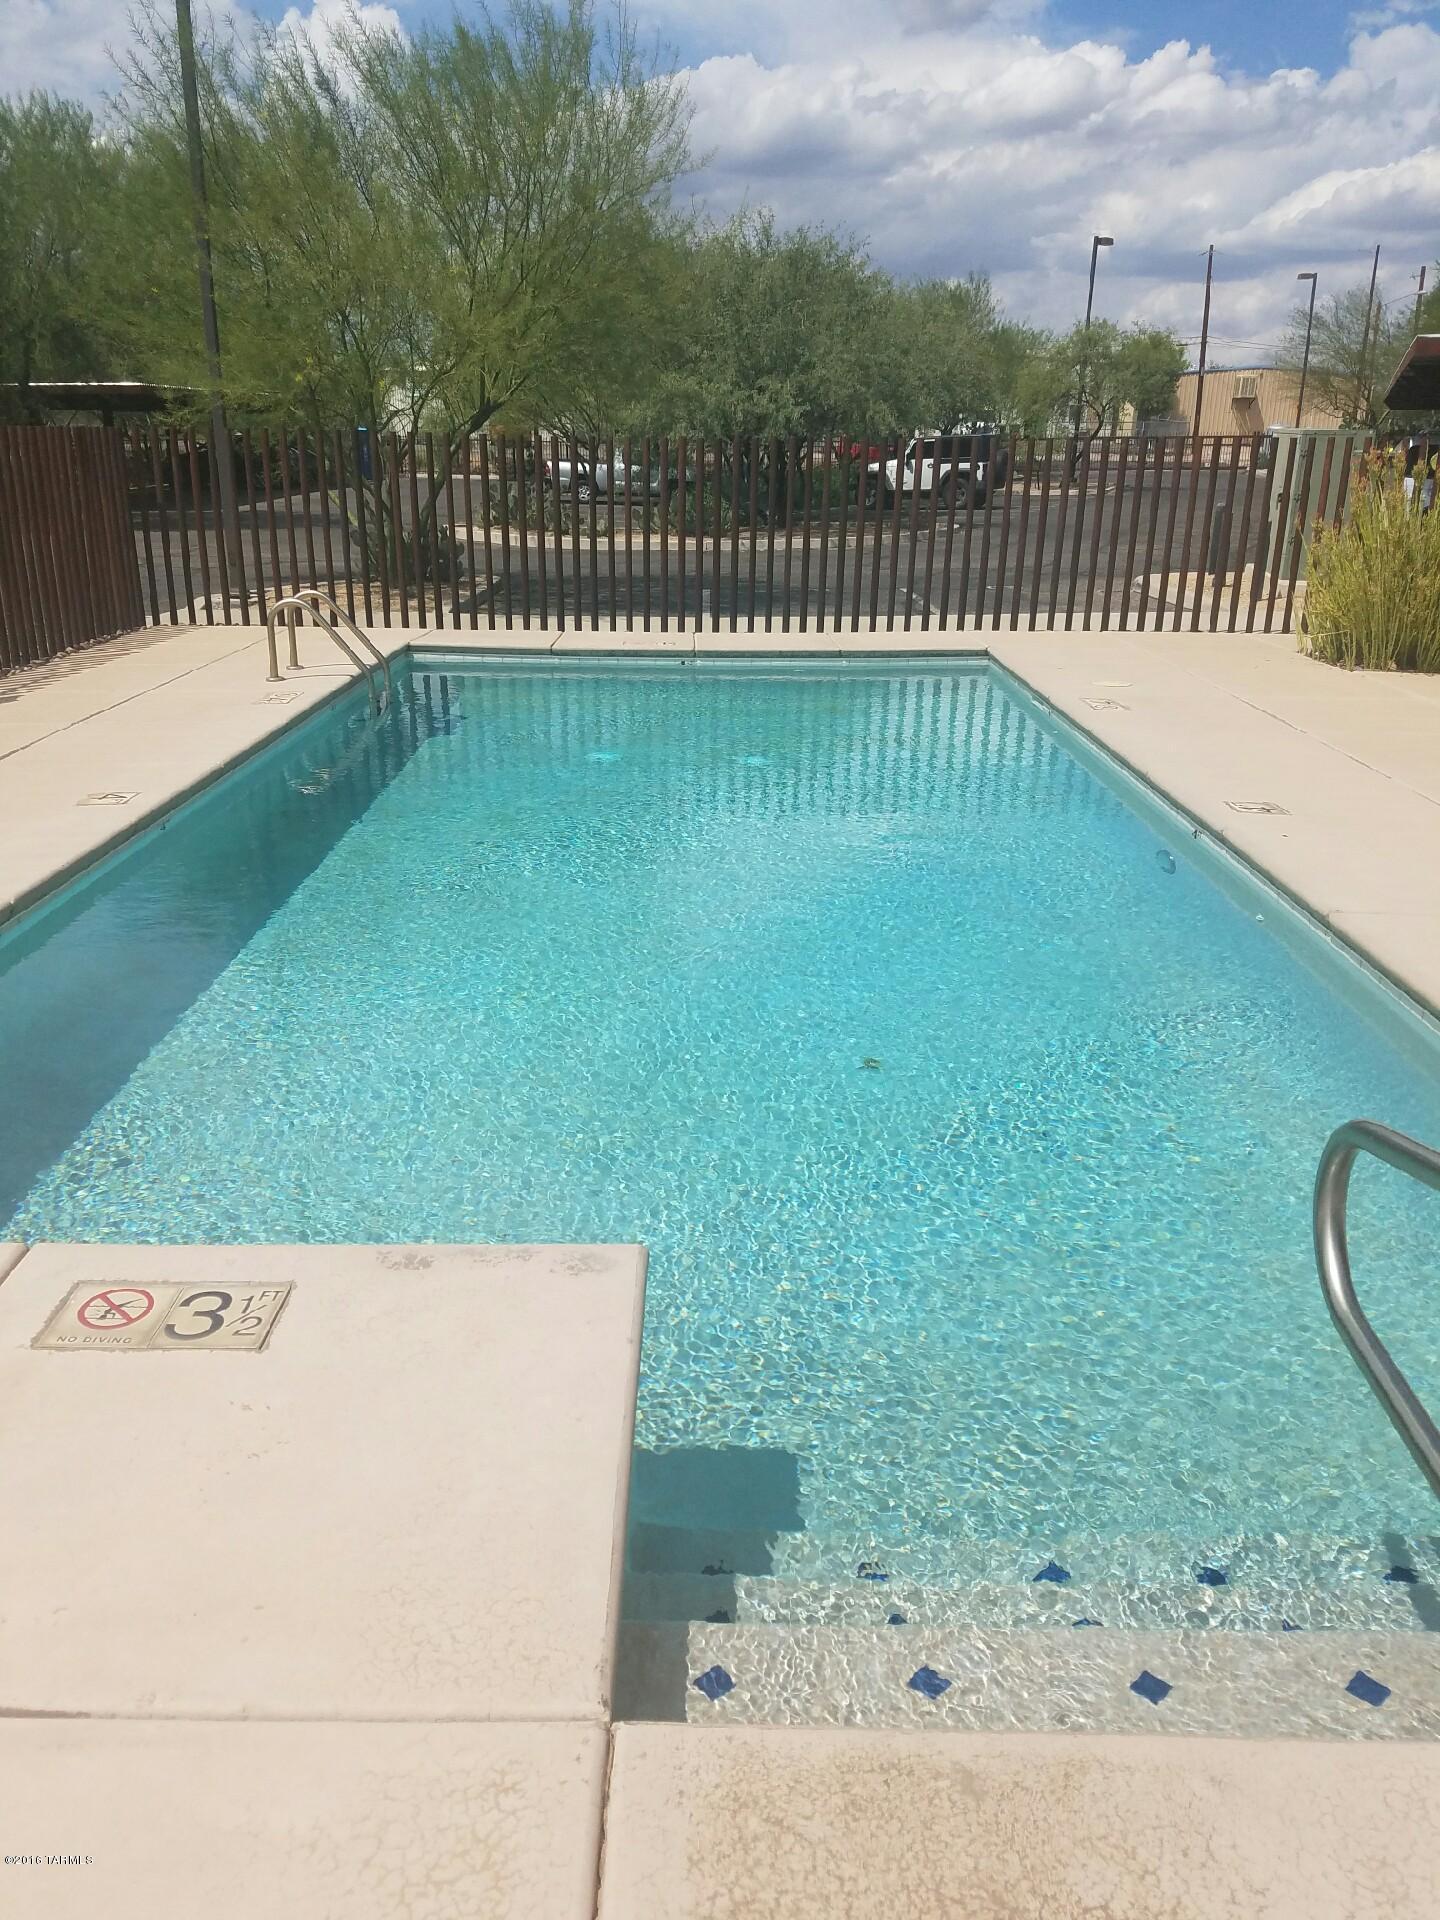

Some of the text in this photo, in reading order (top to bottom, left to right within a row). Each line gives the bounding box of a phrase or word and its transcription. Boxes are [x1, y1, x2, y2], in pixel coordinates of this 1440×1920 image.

[164, 1290, 233, 1341] 3
[258, 1290, 284, 1303] FT
[56, 1335, 133, 1345] NO DIVING
